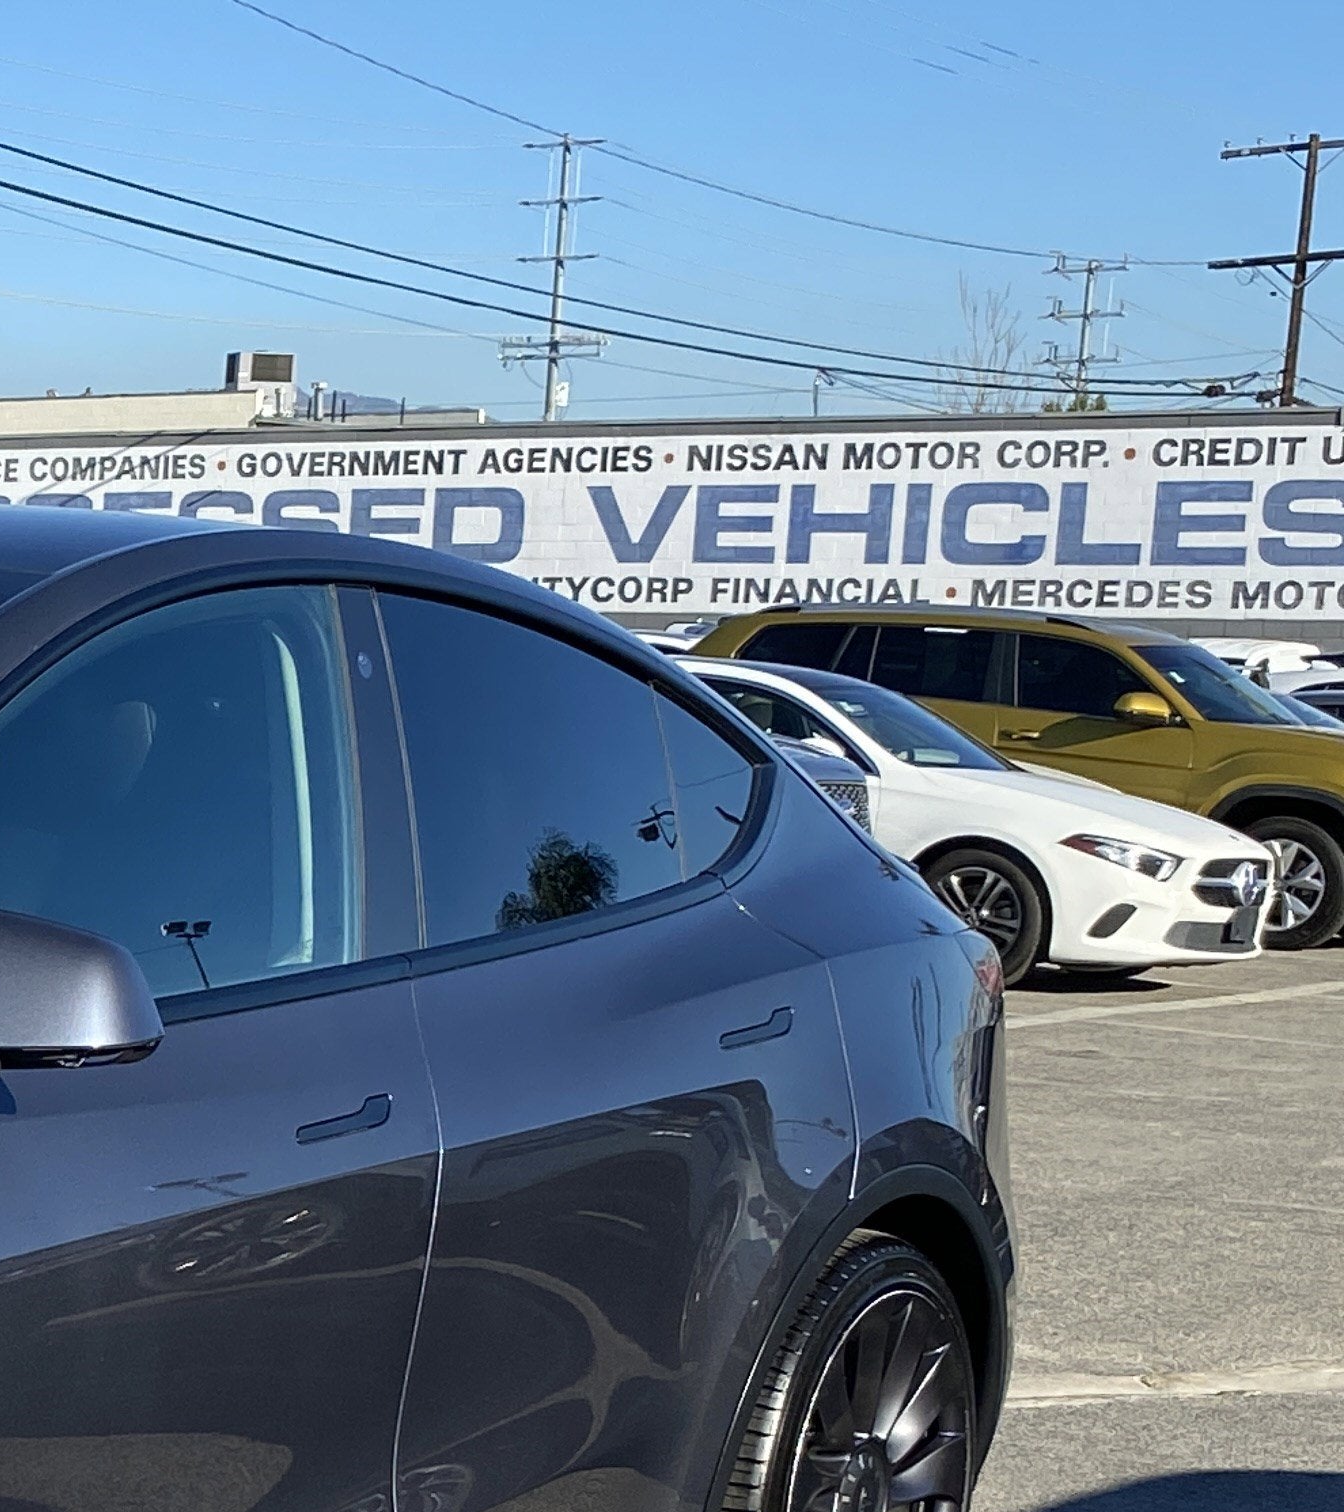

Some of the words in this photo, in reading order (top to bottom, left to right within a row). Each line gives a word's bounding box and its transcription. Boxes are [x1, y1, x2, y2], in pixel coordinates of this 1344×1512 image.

[29, 453, 206, 482] COMPANIES
[236, 449, 467, 479] GOVERNMENT
[477, 445, 653, 475] AGENCIES
[686, 443, 829, 472] NISSAN
[842, 441, 981, 471] MOTOR
[997, 439, 1109, 469] CORP.
[1152, 436, 1307, 467] CREDIT
[587, 480, 1344, 566] VEHICLES
[710, 577, 929, 604] FINANCIAL
[970, 579, 1212, 610] MERCEDES
[1230, 579, 1344, 611] MOT
